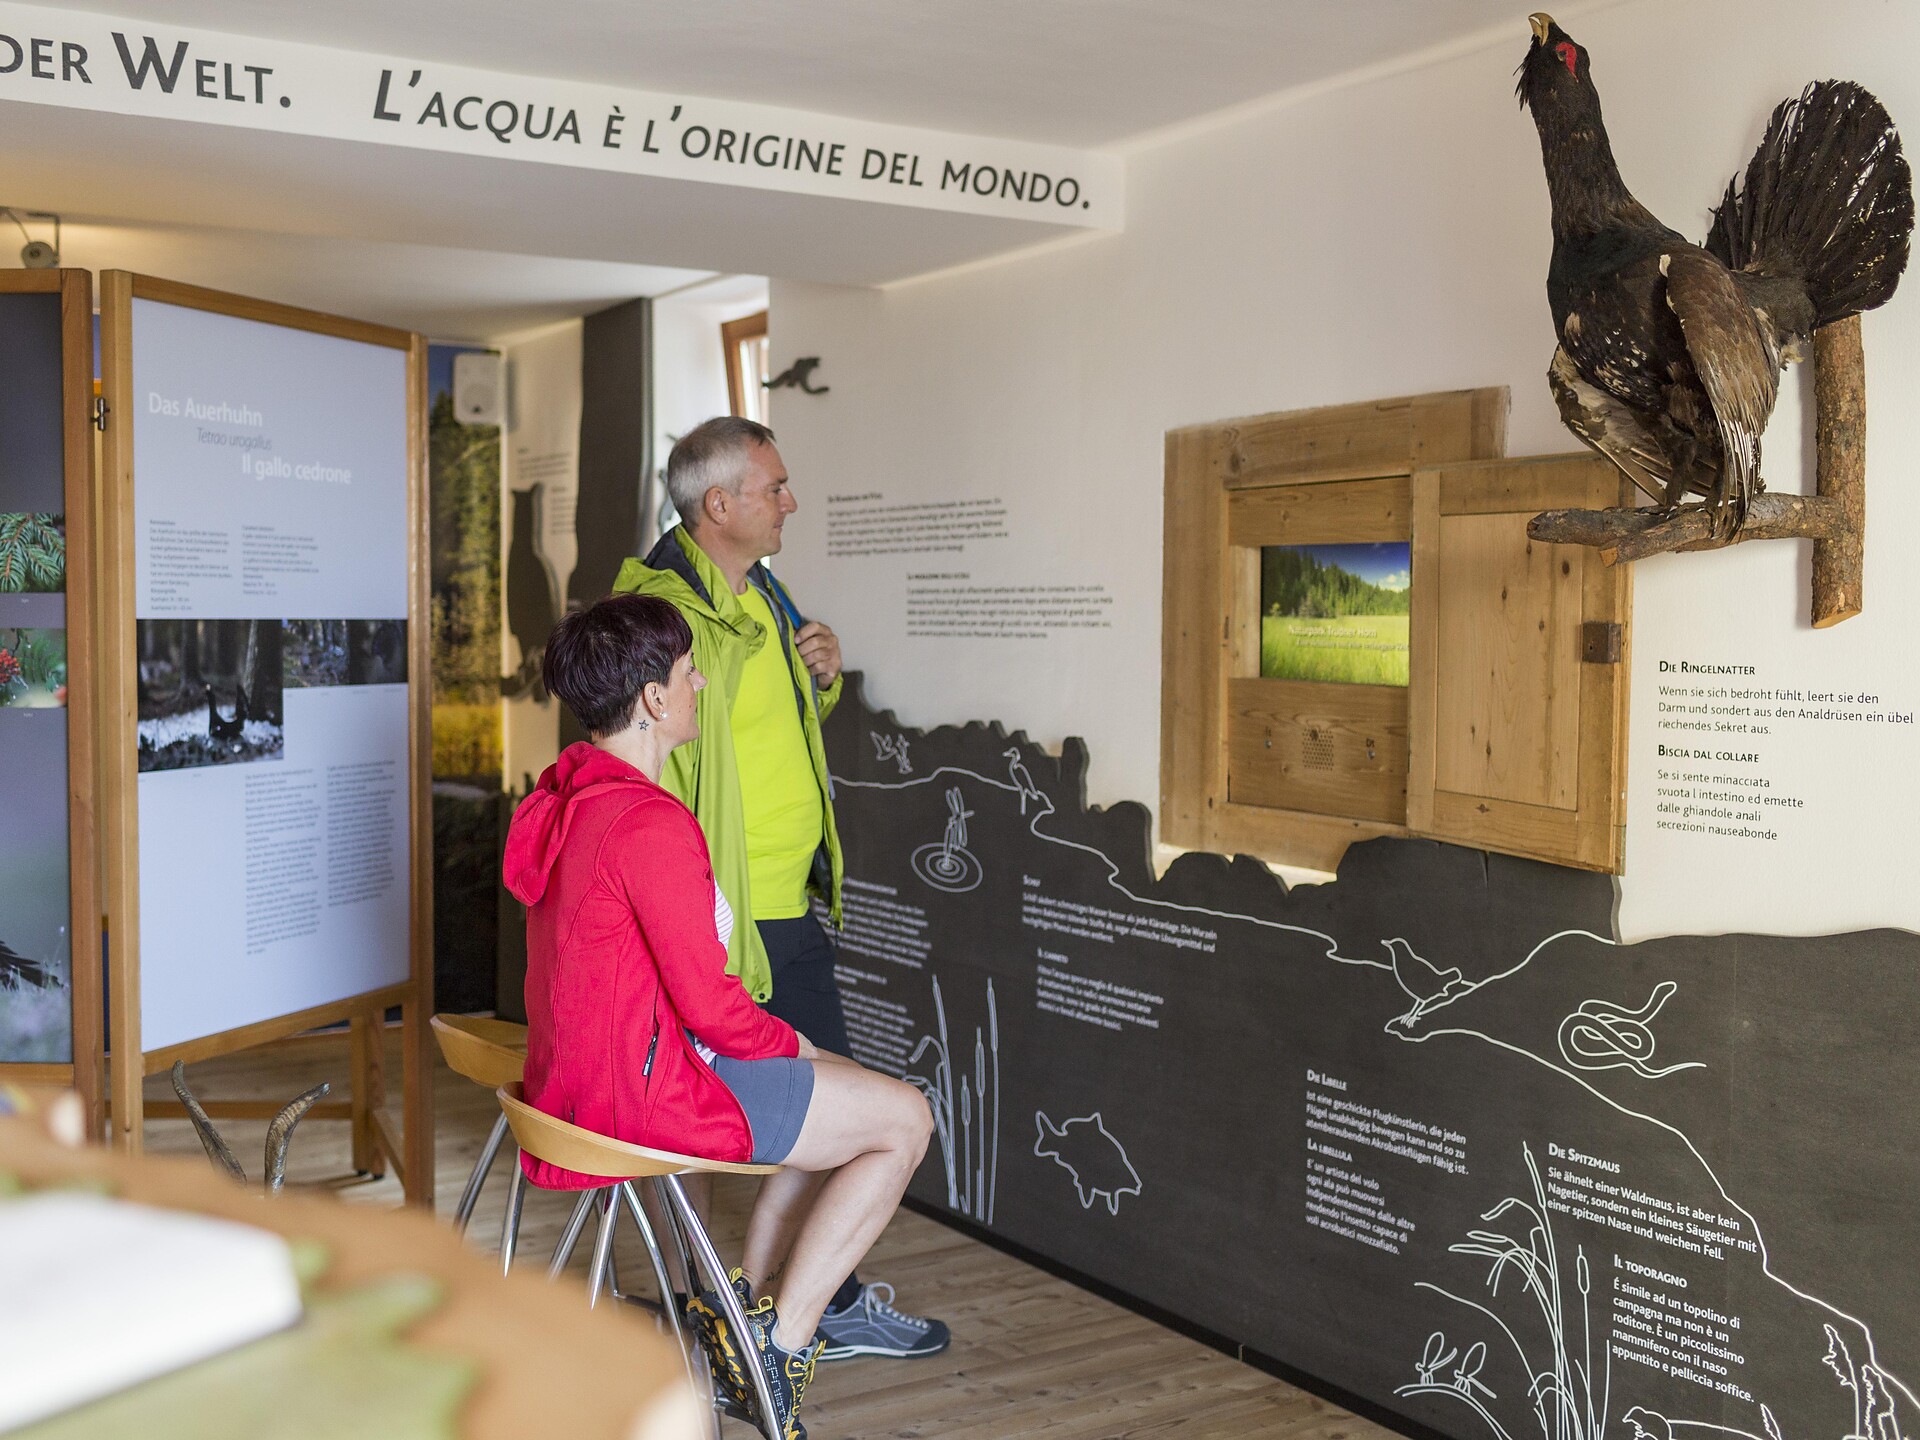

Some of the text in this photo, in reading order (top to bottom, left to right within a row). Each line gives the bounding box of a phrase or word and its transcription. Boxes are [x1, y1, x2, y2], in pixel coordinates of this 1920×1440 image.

[0, 31, 291, 108] DER WELT.
[373, 68, 581, 145] L'ACQUA
[602, 105, 626, 149] È
[860, 148, 924, 187] DEL
[940, 160, 1091, 210] MONDO.
[149, 392, 262, 427] Das Auerhuhn
[197, 427, 272, 451] Tetrao urogallus
[242, 454, 352, 484] Il gallo cedrone
[1660, 661, 1755, 675] DIE RINGELNATTER
[1659, 686, 1878, 703] Wenn sie sich bedroht fühlt, leert sie den
[1659, 702, 1913, 723] Darm und sondert aus den Analdrüsen ein übel
[1659, 719, 1771, 734] riechendes Sekret aus.
[1659, 745, 1758, 762] BISCIA DAL COLLARE
[1658, 770, 1769, 787] Se si sente minacciata
[1657, 802, 1760, 821] dalle ghiandole anali
[1658, 788, 1689, 797] svuota
[1748, 794, 1760, 804] ed
[1764, 798, 1803, 807] emette
[1657, 821, 1777, 840] secrezioni nauseabonde
[1306, 1104, 1465, 1159] Flügel unabhängig bewegen kann und so zu
[1317, 1095, 1332, 1106] eine
[1333, 1099, 1371, 1118] geschickte
[1372, 1109, 1428, 1135] Flugkünstlerin,
[1429, 1126, 1442, 1138] die
[1443, 1129, 1466, 1144] jeden
[1433, 1155, 1453, 1173] fähig
[1549, 1143, 1620, 1173] DIE SPITZMAUS
[1306, 1174, 1385, 1206] ogni ala può muoversi
[1315, 1162, 1324, 1172] un
[1325, 1167, 1349, 1181] artista
[1350, 1173, 1362, 1185] del
[1363, 1179, 1380, 1190] volo
[1548, 1167, 1739, 1230] Sie ähnelt einer Waldmaus, ist aber kein
[1306, 1201, 1340, 1219] rendendo
[1372, 1225, 1398, 1239] capace
[1399, 1232, 1408, 1243] di
[1306, 1215, 1319, 1225] voli
[1320, 1220, 1355, 1239] acrobatici
[1377, 1209, 1395, 1224] dalle
[1397, 1218, 1415, 1231] altre
[1548, 1182, 1757, 1252] Nagetier, sondern ein kleines Säugetier mit
[1548, 1199, 1724, 1260] einer spitzen Nase und weichem Fell.
[1625, 1261, 1687, 1287] TOPORAGNO
[1613, 1298, 1729, 1342] campagna ma non è un
[1622, 1283, 1650, 1300] simile
[1653, 1294, 1665, 1304] ad
[1668, 1299, 1681, 1309] un
[1683, 1302, 1727, 1324] topolino
[1730, 1317, 1740, 1329] di
[1613, 1313, 1654, 1334] roditore.
[1665, 1331, 1677, 1342] un
[1681, 1336, 1744, 1364] piccolissimo
[1613, 1329, 1727, 1375] mammifero con il naso
[1613, 1345, 1754, 1402] appuntito e pelliccia soffice.
